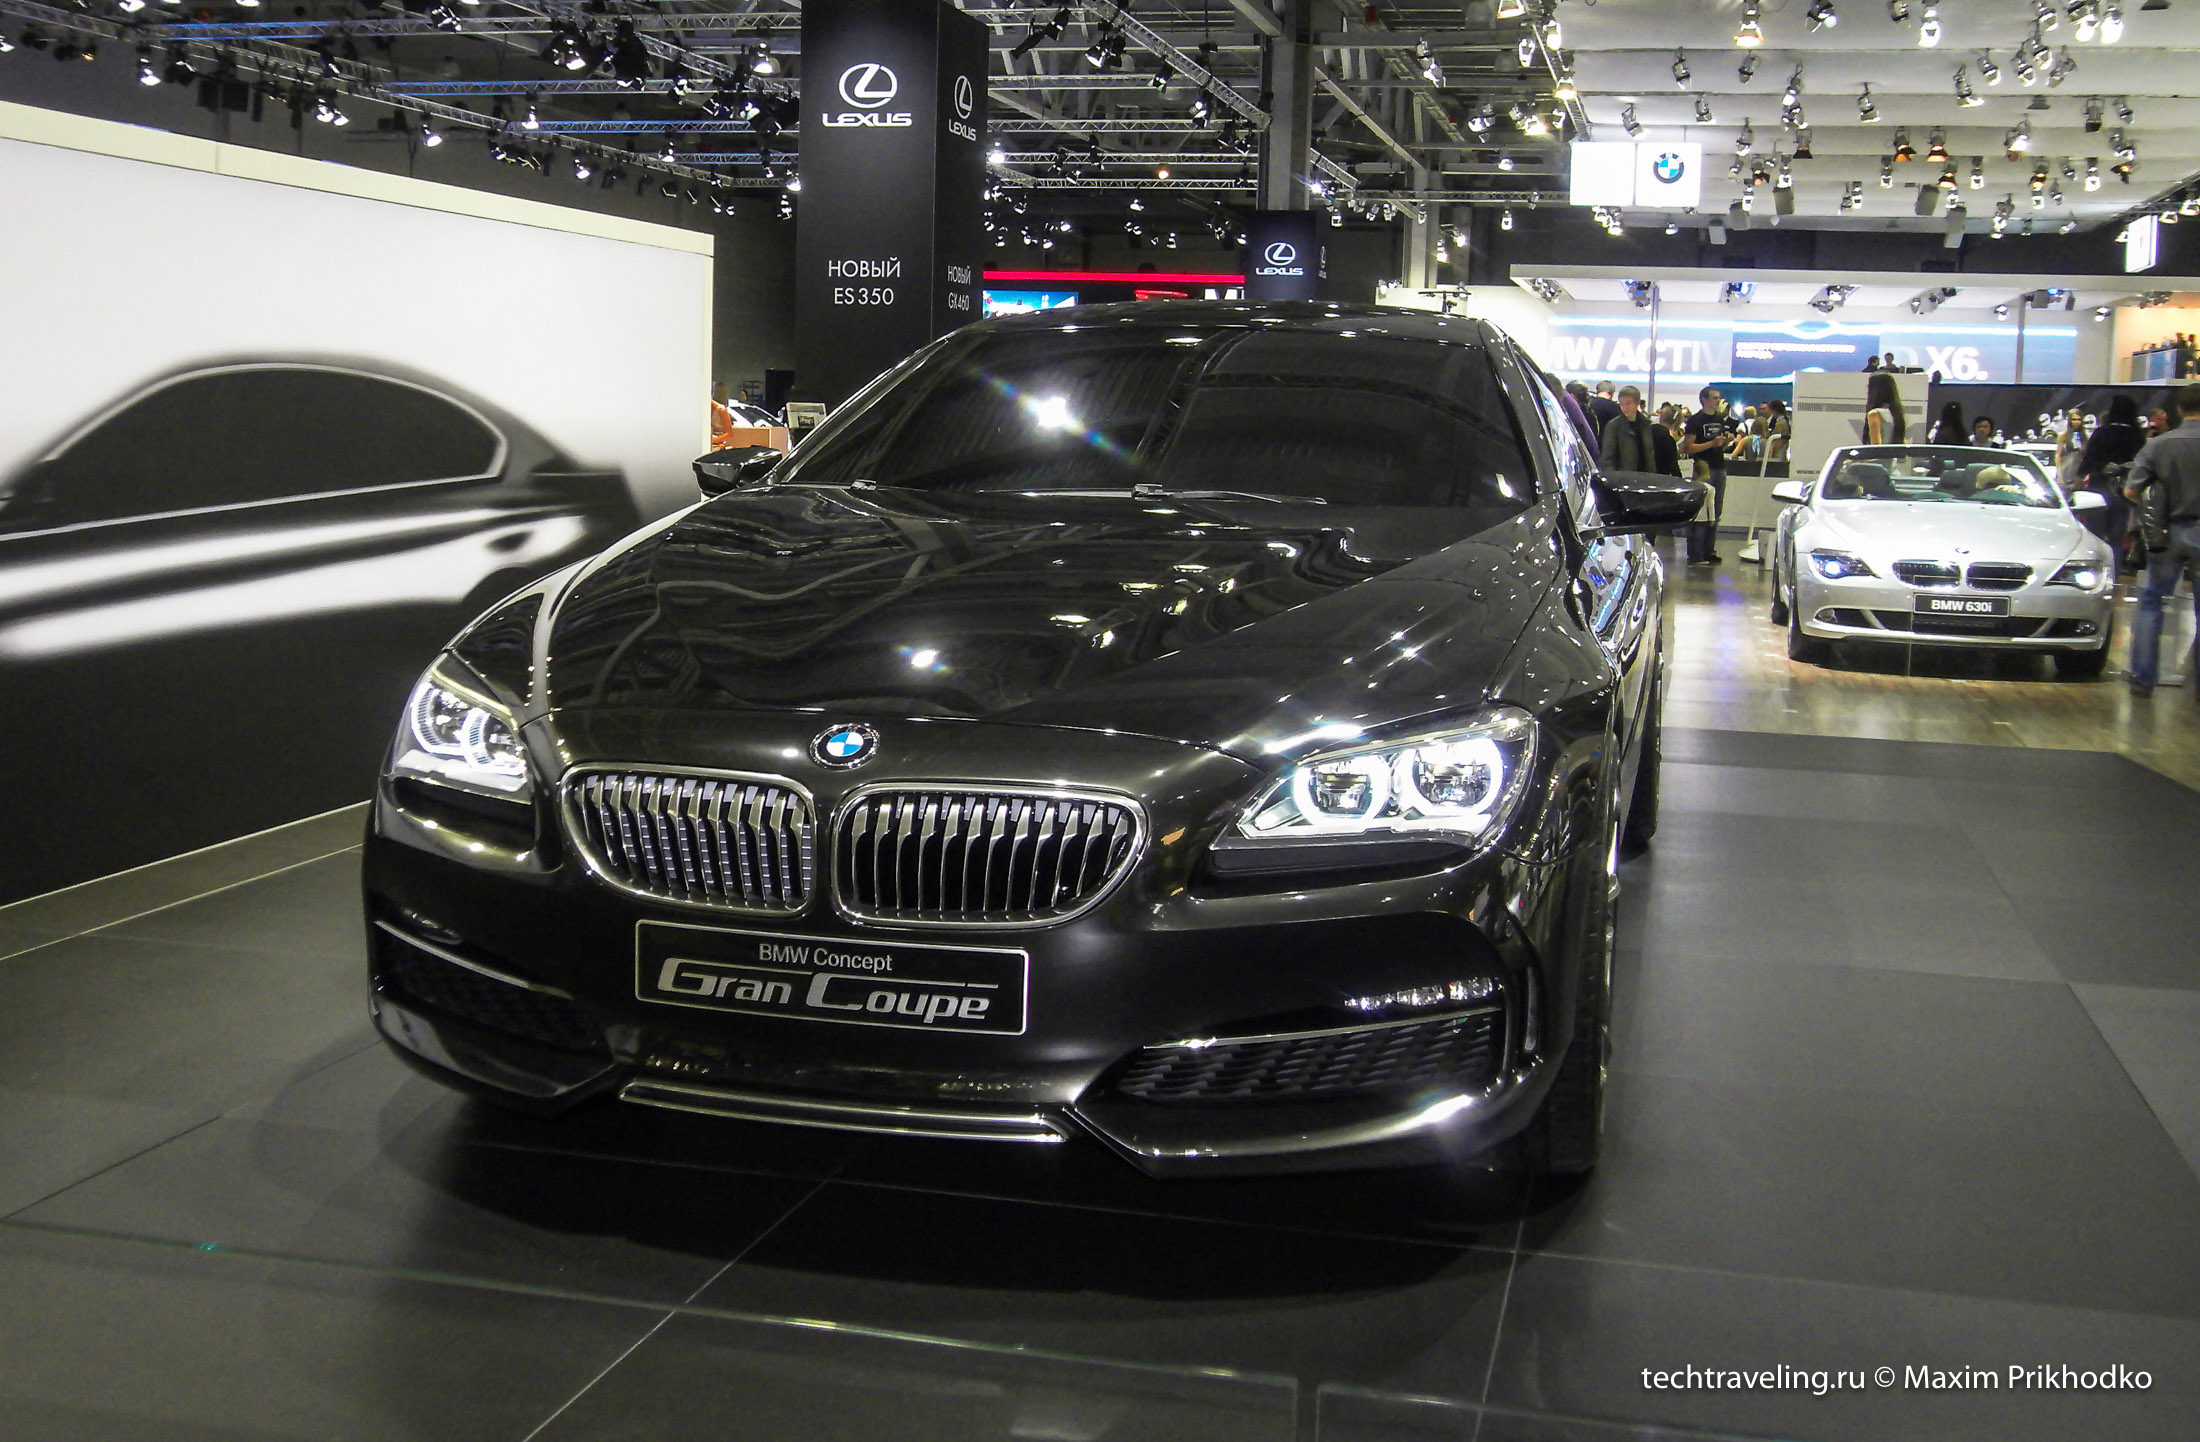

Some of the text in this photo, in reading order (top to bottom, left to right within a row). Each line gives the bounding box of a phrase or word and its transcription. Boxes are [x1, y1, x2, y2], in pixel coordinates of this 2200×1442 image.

[822, 112, 912, 127] LEXUS
[948, 118, 977, 142] LEXUS
[828, 257, 900, 278] НОВЫЙ
[947, 265, 971, 285] НОВЫЙ
[1255, 267, 1304, 276] LEXUS
[1931, 599, 1993, 613] BMW 630i
[759, 943, 893, 973] BMW Concept
[657, 957, 796, 1005] Gran
